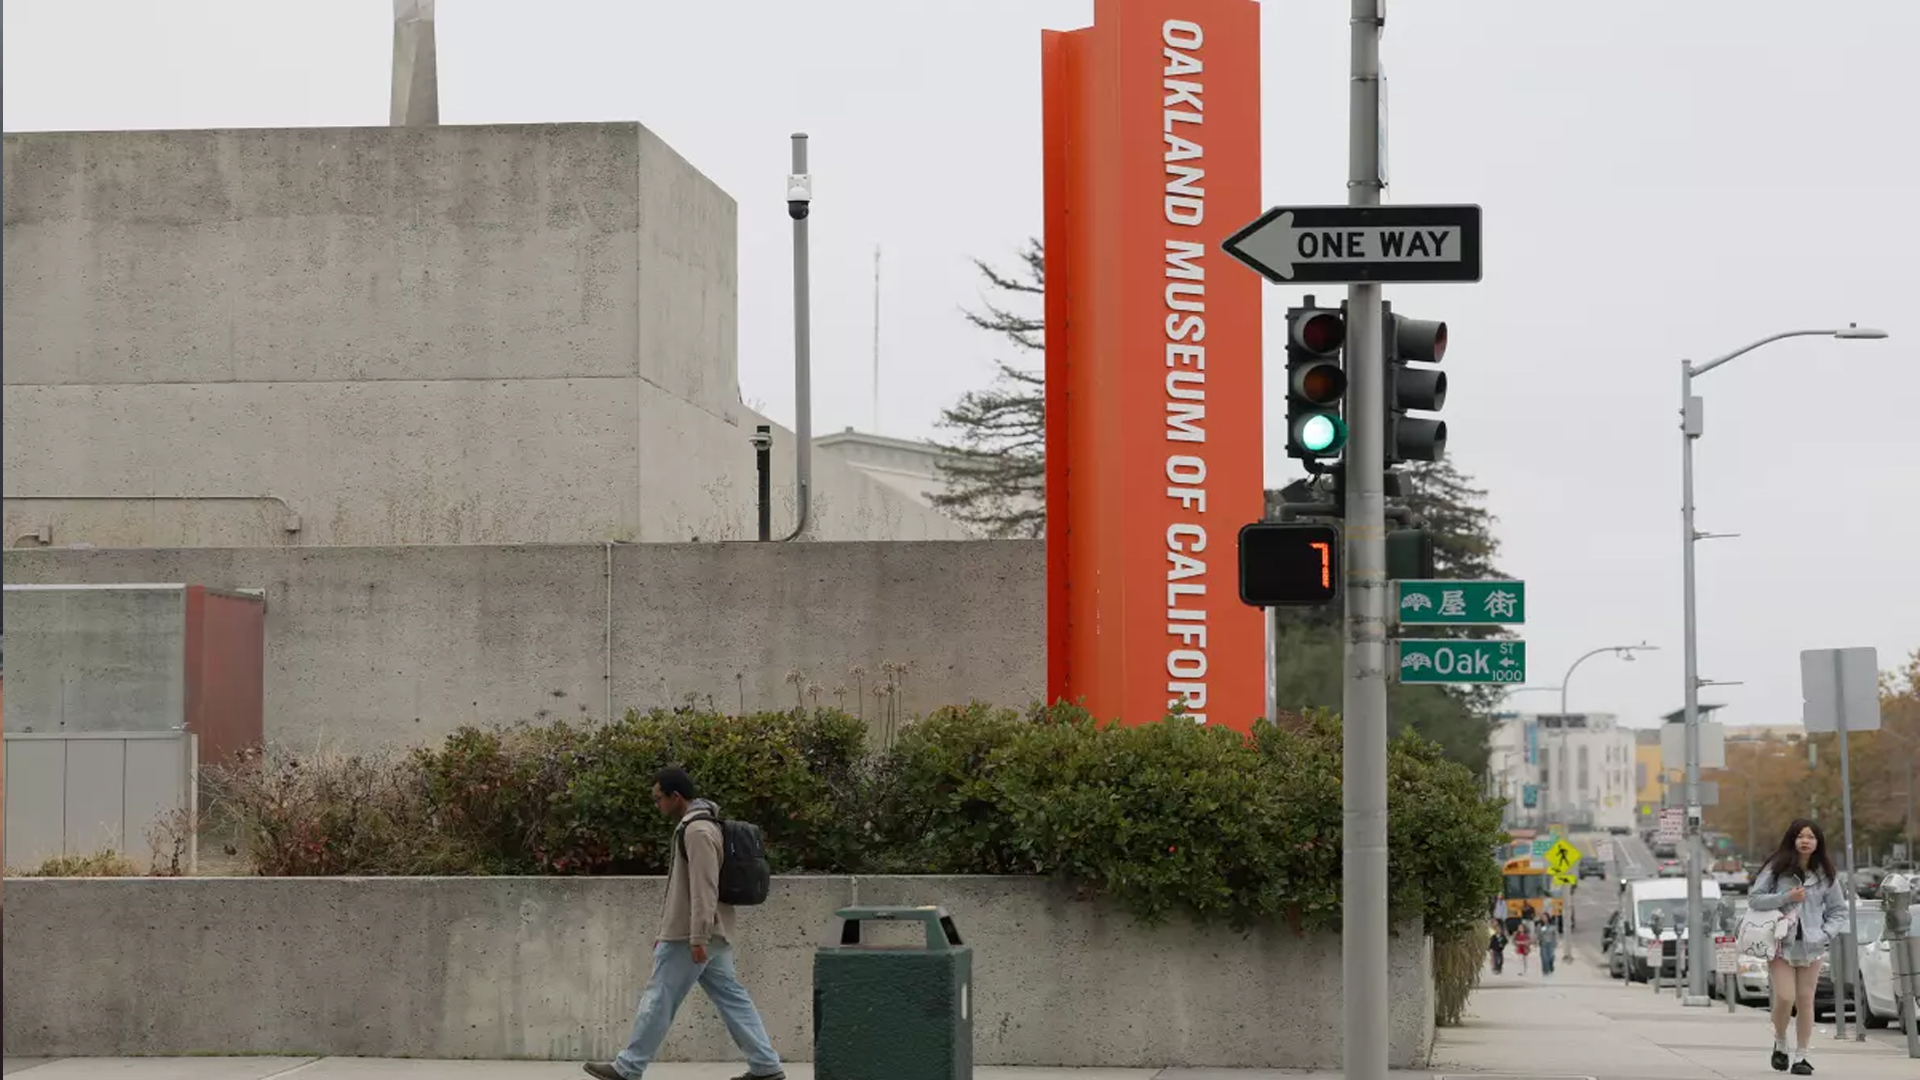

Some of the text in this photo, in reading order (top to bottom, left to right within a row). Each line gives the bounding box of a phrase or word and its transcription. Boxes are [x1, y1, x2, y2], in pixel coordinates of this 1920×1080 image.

[1297, 231, 1451, 259] ONE WAY
[1162, 18, 1208, 724] OAKLAND MUSEUM OF CALIFOR
[1434, 647, 1490, 674] Oak
[1499, 642, 1515, 654] ST
[1492, 669, 1522, 681] 1000
